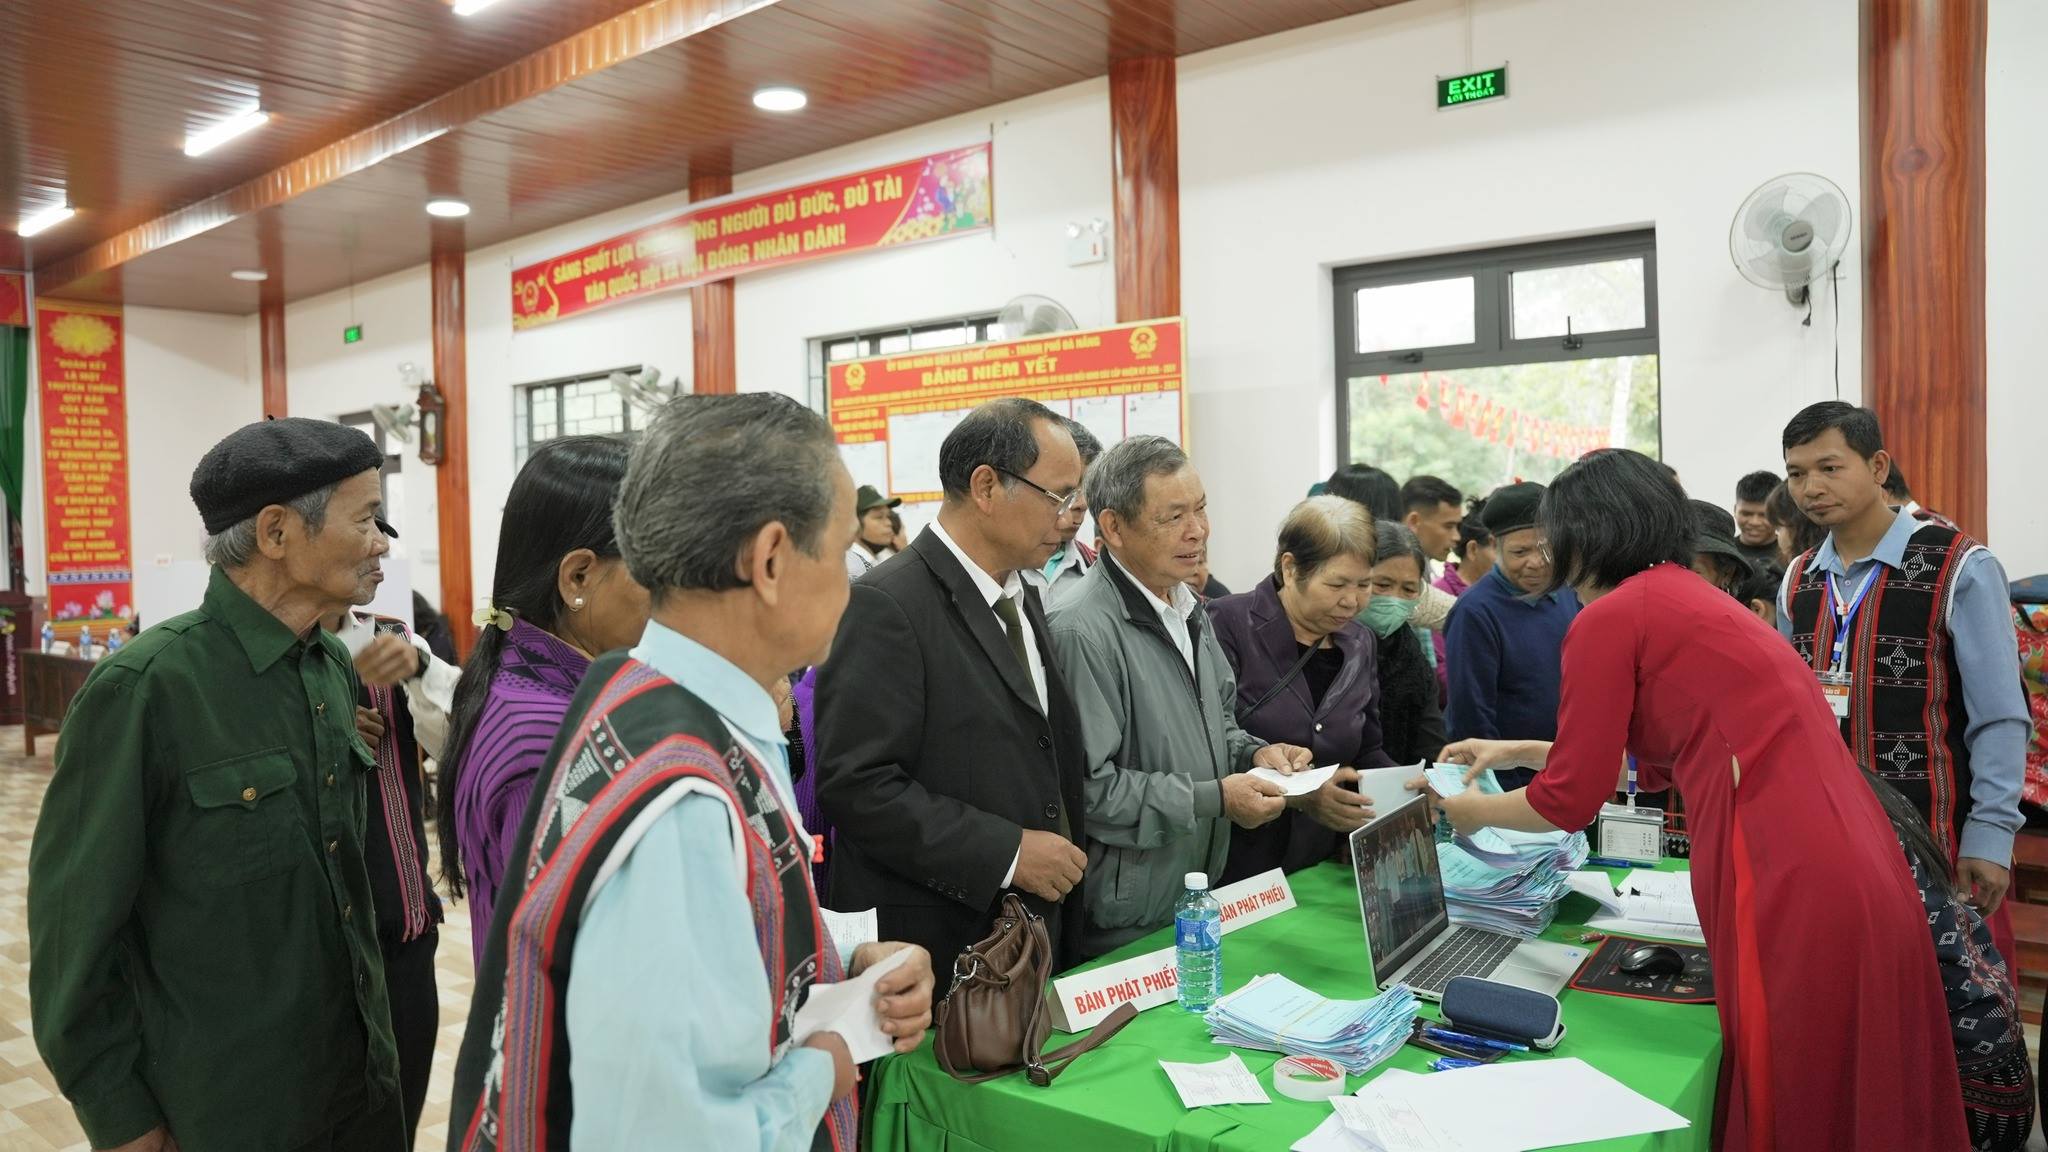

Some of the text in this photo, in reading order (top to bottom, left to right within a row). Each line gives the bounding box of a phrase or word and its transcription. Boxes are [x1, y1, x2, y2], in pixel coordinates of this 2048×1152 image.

[1449, 73, 1495, 95] EXIT
[553, 260, 582, 285] SÁNG
[583, 247, 610, 275] SUỐT
[721, 203, 770, 237] NGƯỜI
[773, 194, 795, 224] ĐỦ
[799, 189, 840, 218] ĐỨC,
[844, 177, 869, 208] ĐỦ
[873, 174, 903, 203] TÀI
[584, 279, 606, 303] VÀO
[608, 267, 638, 298] QUỐC
[707, 241, 749, 270] ĐỒNG
[754, 232, 799, 260] NHÂN
[804, 223, 846, 251] DÂN!
[921, 366, 968, 387] BẢNG
[972, 361, 1019, 381] NIÊM
[1024, 355, 1058, 374] YẾT
[1236, 894, 1260, 916] PHÁT
[1260, 883, 1286, 907] PHIẾU
[1074, 990, 1106, 1015] BÀN
[1106, 978, 1142, 1005] PHÁT
